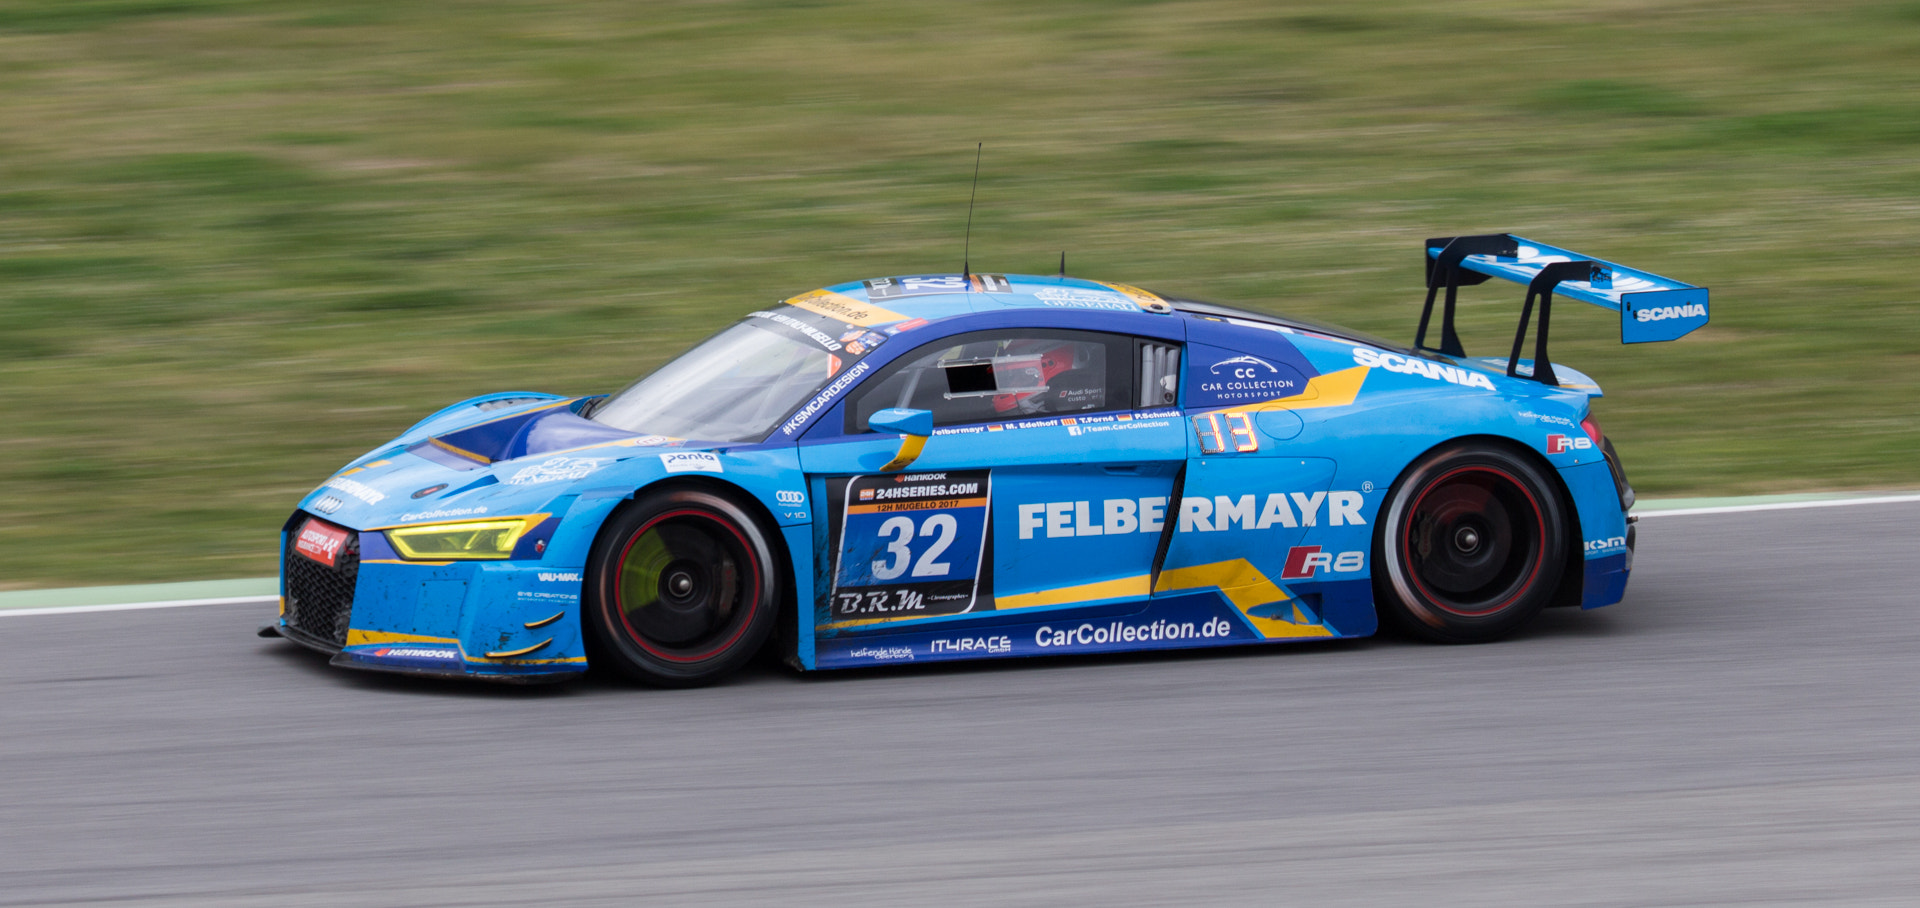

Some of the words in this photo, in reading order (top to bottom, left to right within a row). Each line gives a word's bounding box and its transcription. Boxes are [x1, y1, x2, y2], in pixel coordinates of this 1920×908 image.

[1637, 303, 1707, 322] SCANIA
[1234, 368, 1256, 379] CC
[1353, 347, 1497, 391] SCANIA
[1084, 388, 1102, 396] Sport
[1201, 383, 1223, 391] CAR
[1226, 380, 1294, 390] COLLECTION
[782, 362, 870, 436] #KSMCARDESIGN
[1217, 391, 1281, 399] MOTORSPORT
[1020, 419, 1058, 429] Edelhoff
[1134, 411, 1180, 420] P.Schmidt
[1207, 412, 1259, 453] 13
[1557, 437, 1592, 451] R8
[876, 483, 978, 499] 24HSERIES.COM
[401, 505, 488, 522] CarCollection.de
[895, 502, 937, 512] MUGELLO
[938, 501, 959, 509] 2017
[1018, 490, 1367, 540] FELBERMAYR
[871, 513, 958, 580] 32
[1300, 550, 1365, 574] R8
[1035, 616, 1231, 648] CarCollection.de
[931, 636, 1011, 653] IT4RACE
